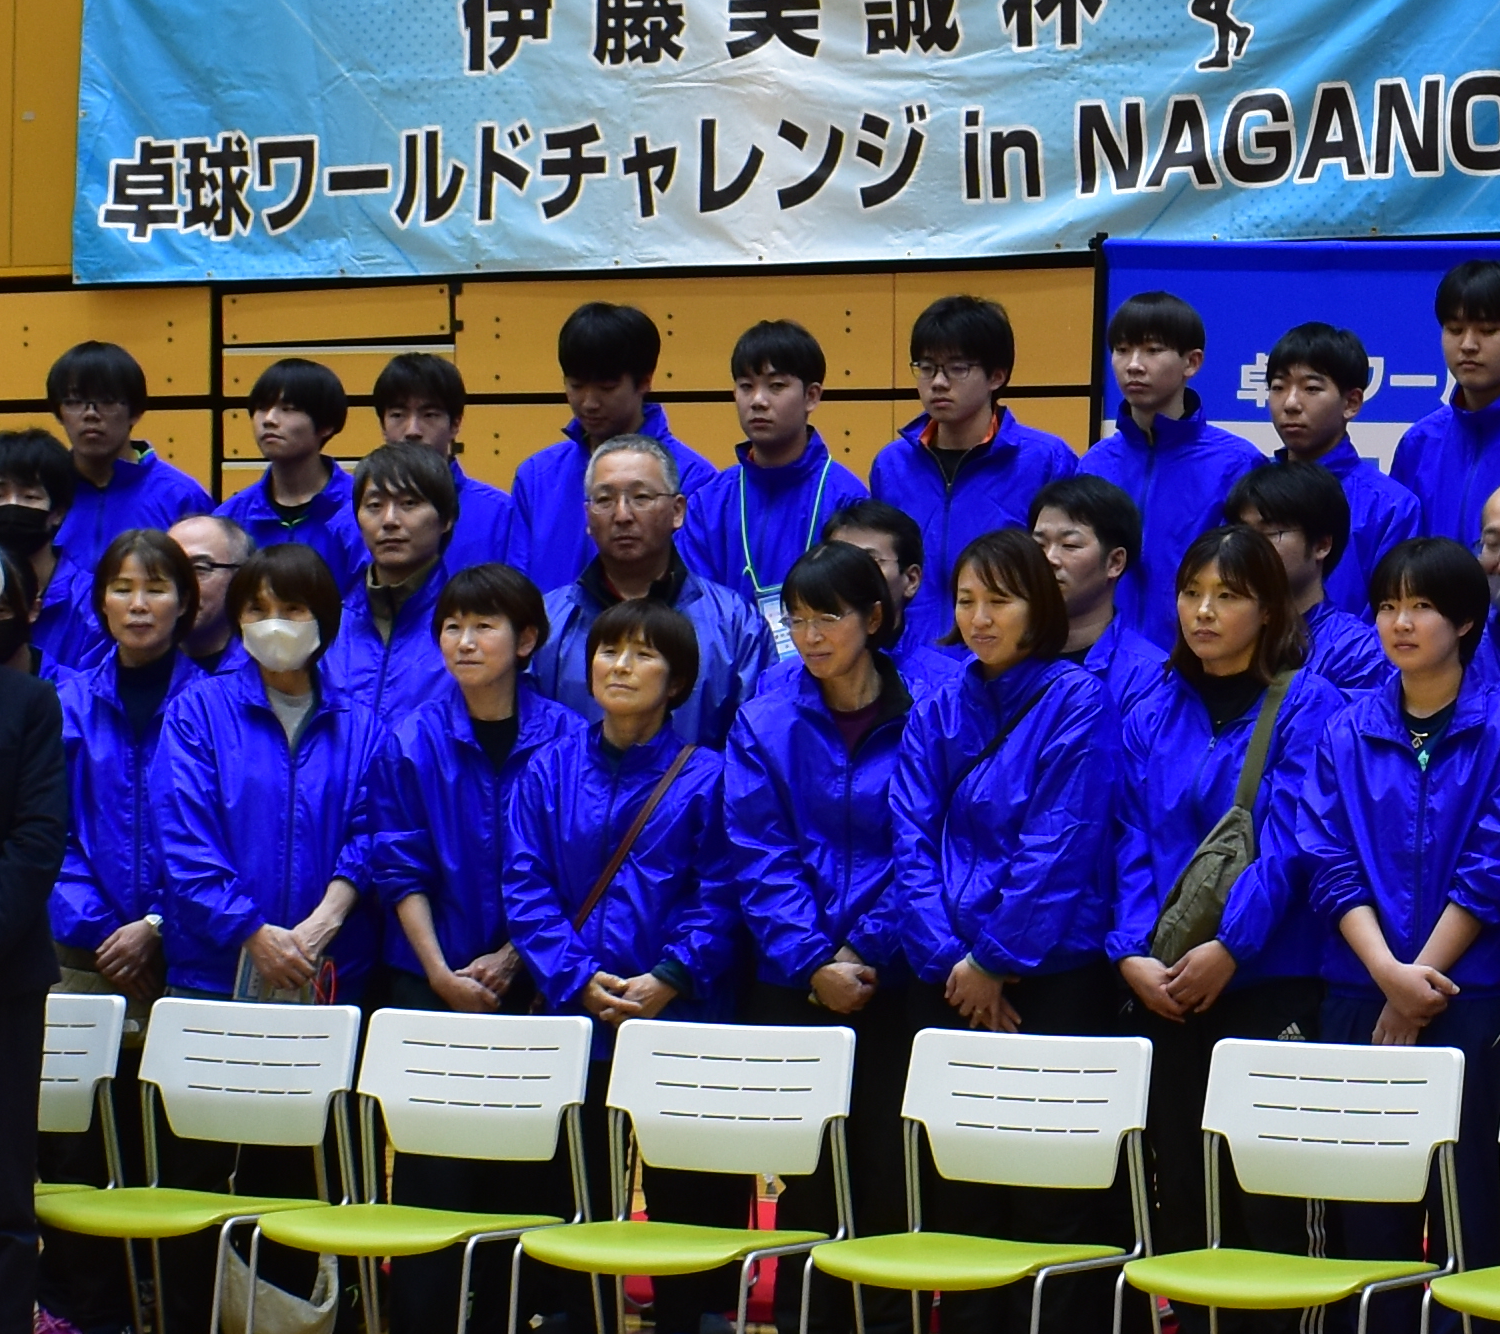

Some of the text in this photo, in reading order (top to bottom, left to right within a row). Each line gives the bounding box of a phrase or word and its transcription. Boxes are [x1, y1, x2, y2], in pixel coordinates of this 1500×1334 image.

[101, 103, 931, 241] 卓球ワールドチャレンジ
[962, 106, 1044, 202] in
